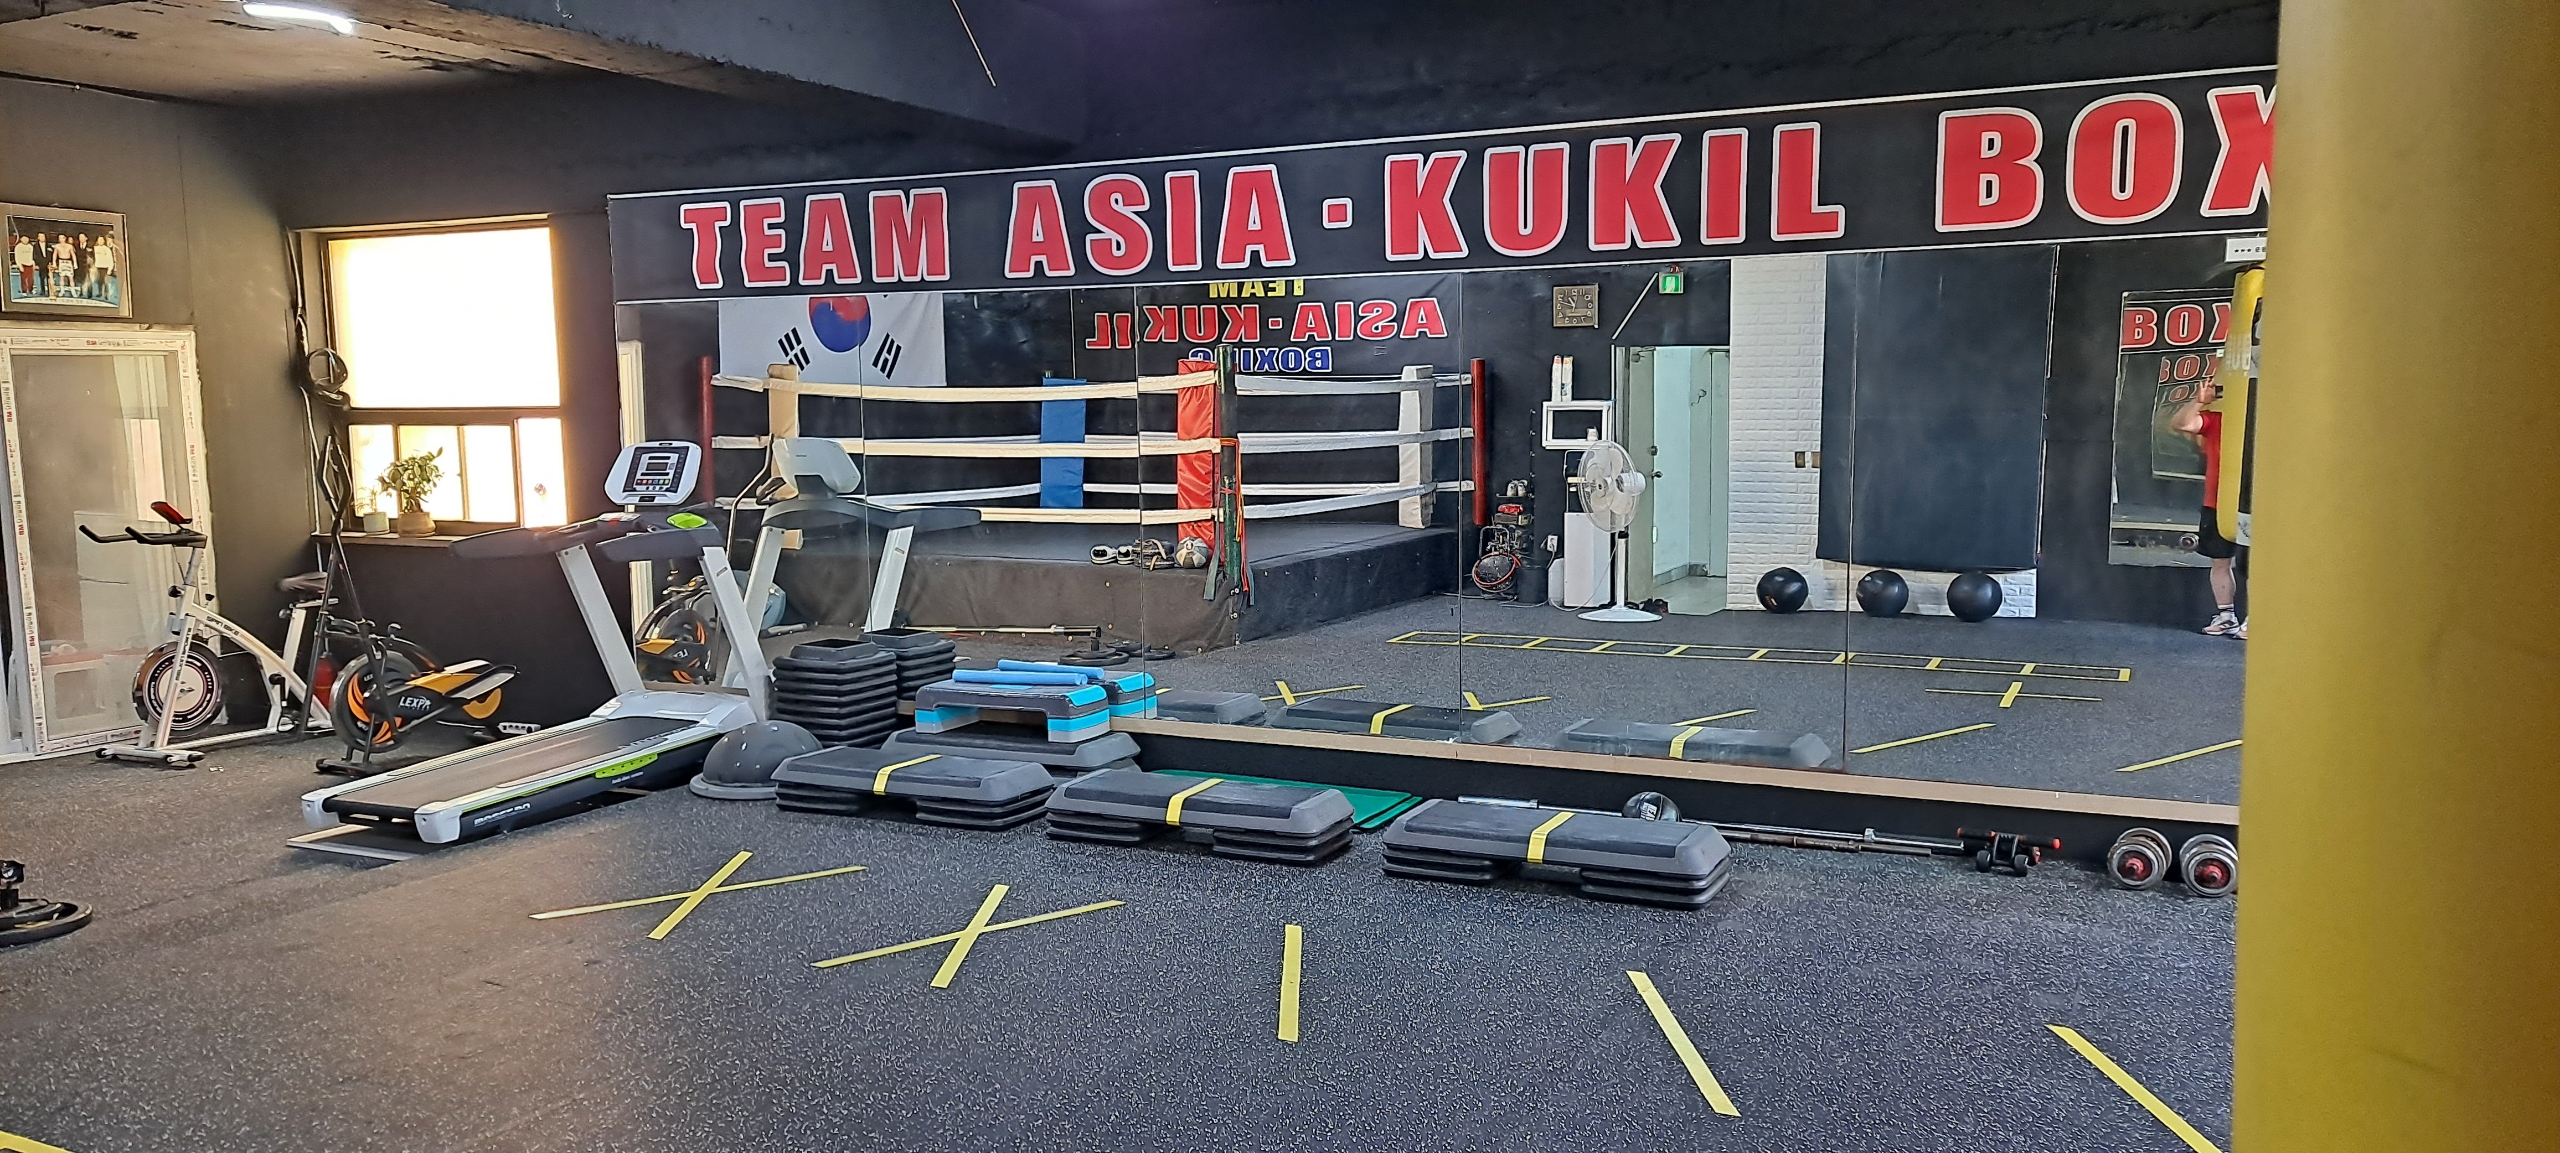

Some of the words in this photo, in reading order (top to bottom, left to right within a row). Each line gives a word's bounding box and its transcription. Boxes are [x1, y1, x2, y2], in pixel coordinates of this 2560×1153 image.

[680, 188, 950, 289] TEAM
[1004, 164, 1296, 277] ASIA
[1384, 121, 1845, 262] KUKIL
